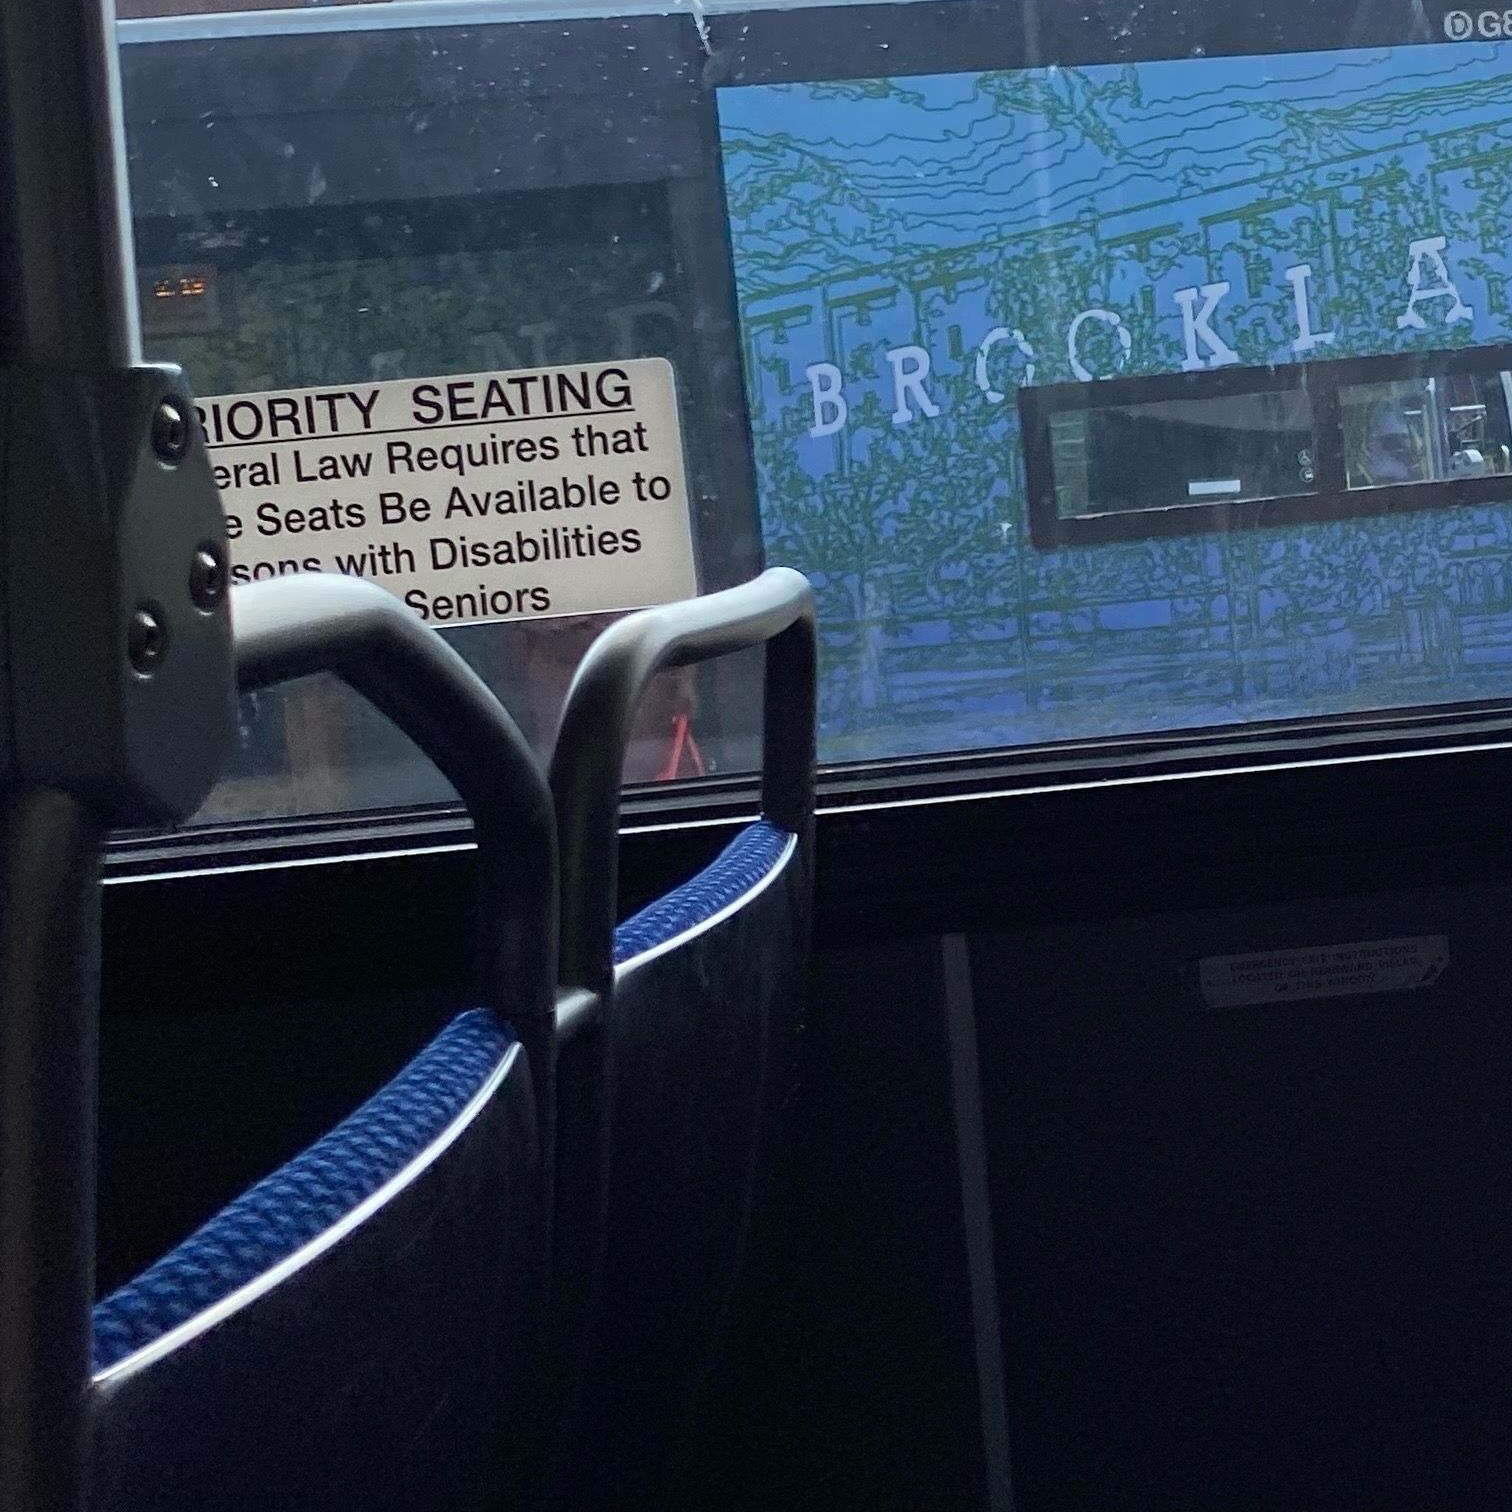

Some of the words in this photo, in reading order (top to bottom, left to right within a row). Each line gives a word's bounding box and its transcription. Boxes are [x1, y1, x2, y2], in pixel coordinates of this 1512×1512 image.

[412, 368, 633, 424] SEATING
[213, 452, 280, 490] eral
[294, 450, 373, 483] Law
[386, 433, 560, 476] Requires
[571, 421, 649, 458] that
[256, 499, 366, 536] Seats
[379, 491, 431, 525] Be
[445, 474, 620, 519] Available
[632, 472, 671, 502] to
[232, 557, 322, 585] sons
[335, 542, 416, 578] with
[429, 525, 642, 570] Disabilities
[405, 584, 551, 621] Seniors
